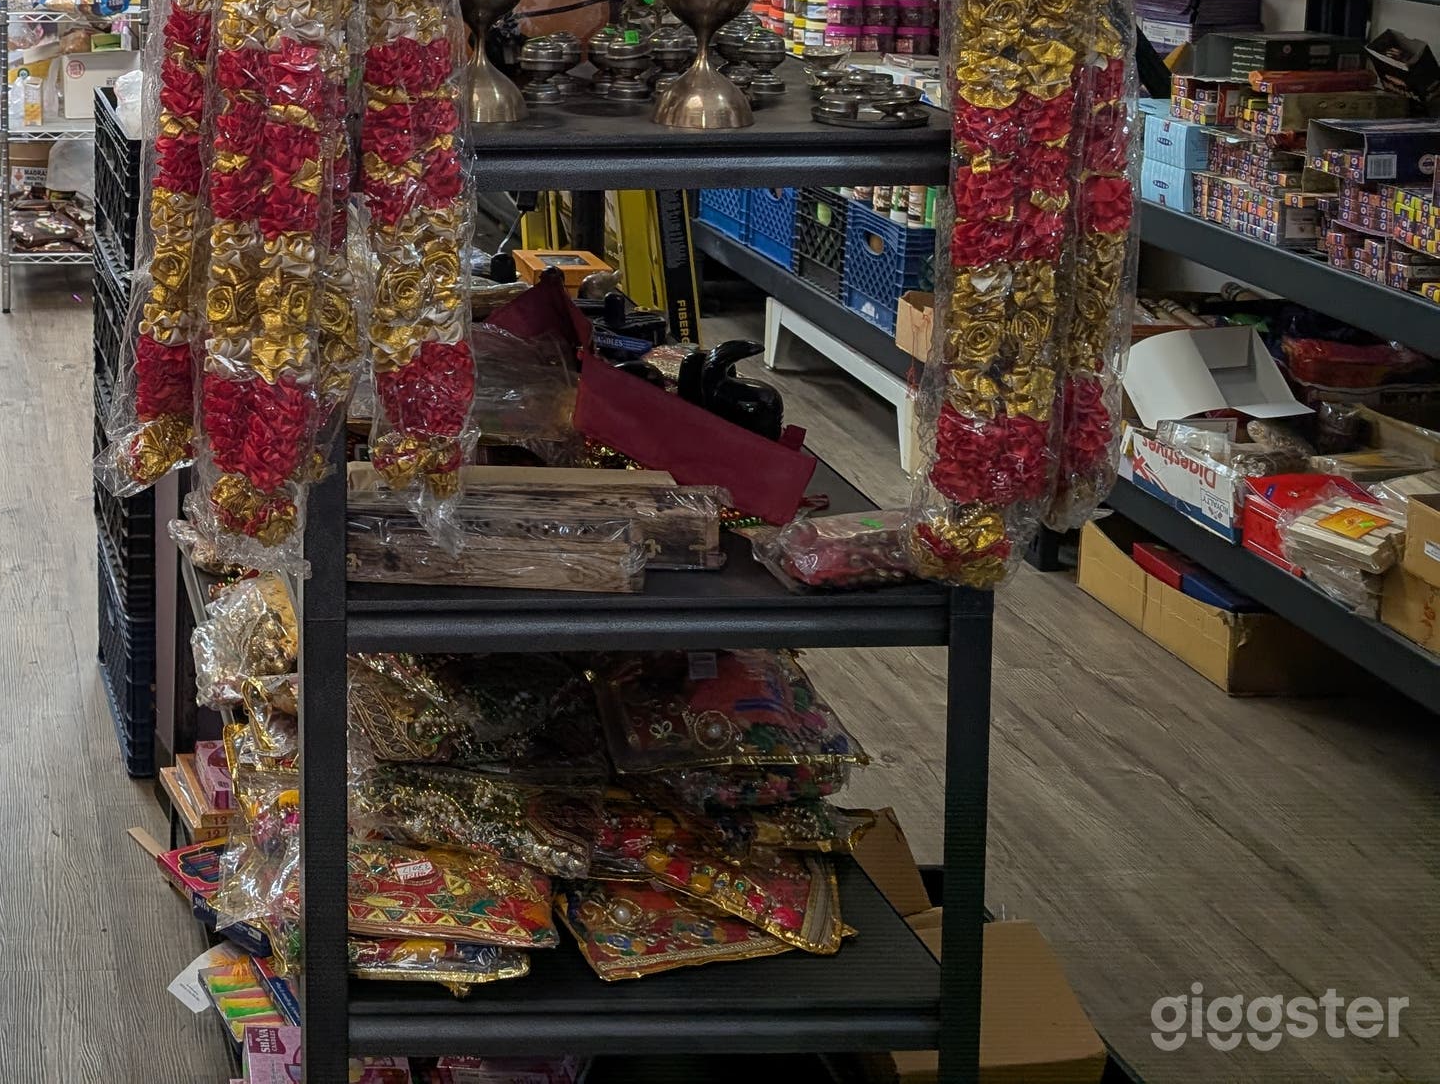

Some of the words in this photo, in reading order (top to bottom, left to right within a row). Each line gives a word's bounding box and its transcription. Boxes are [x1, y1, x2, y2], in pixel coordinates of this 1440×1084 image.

[1141, 437, 1218, 490] Digestives
[1201, 495, 1229, 514] ROYALTY
[213, 817, 228, 825] 12
[255, 1028, 271, 1053] SHIVA
